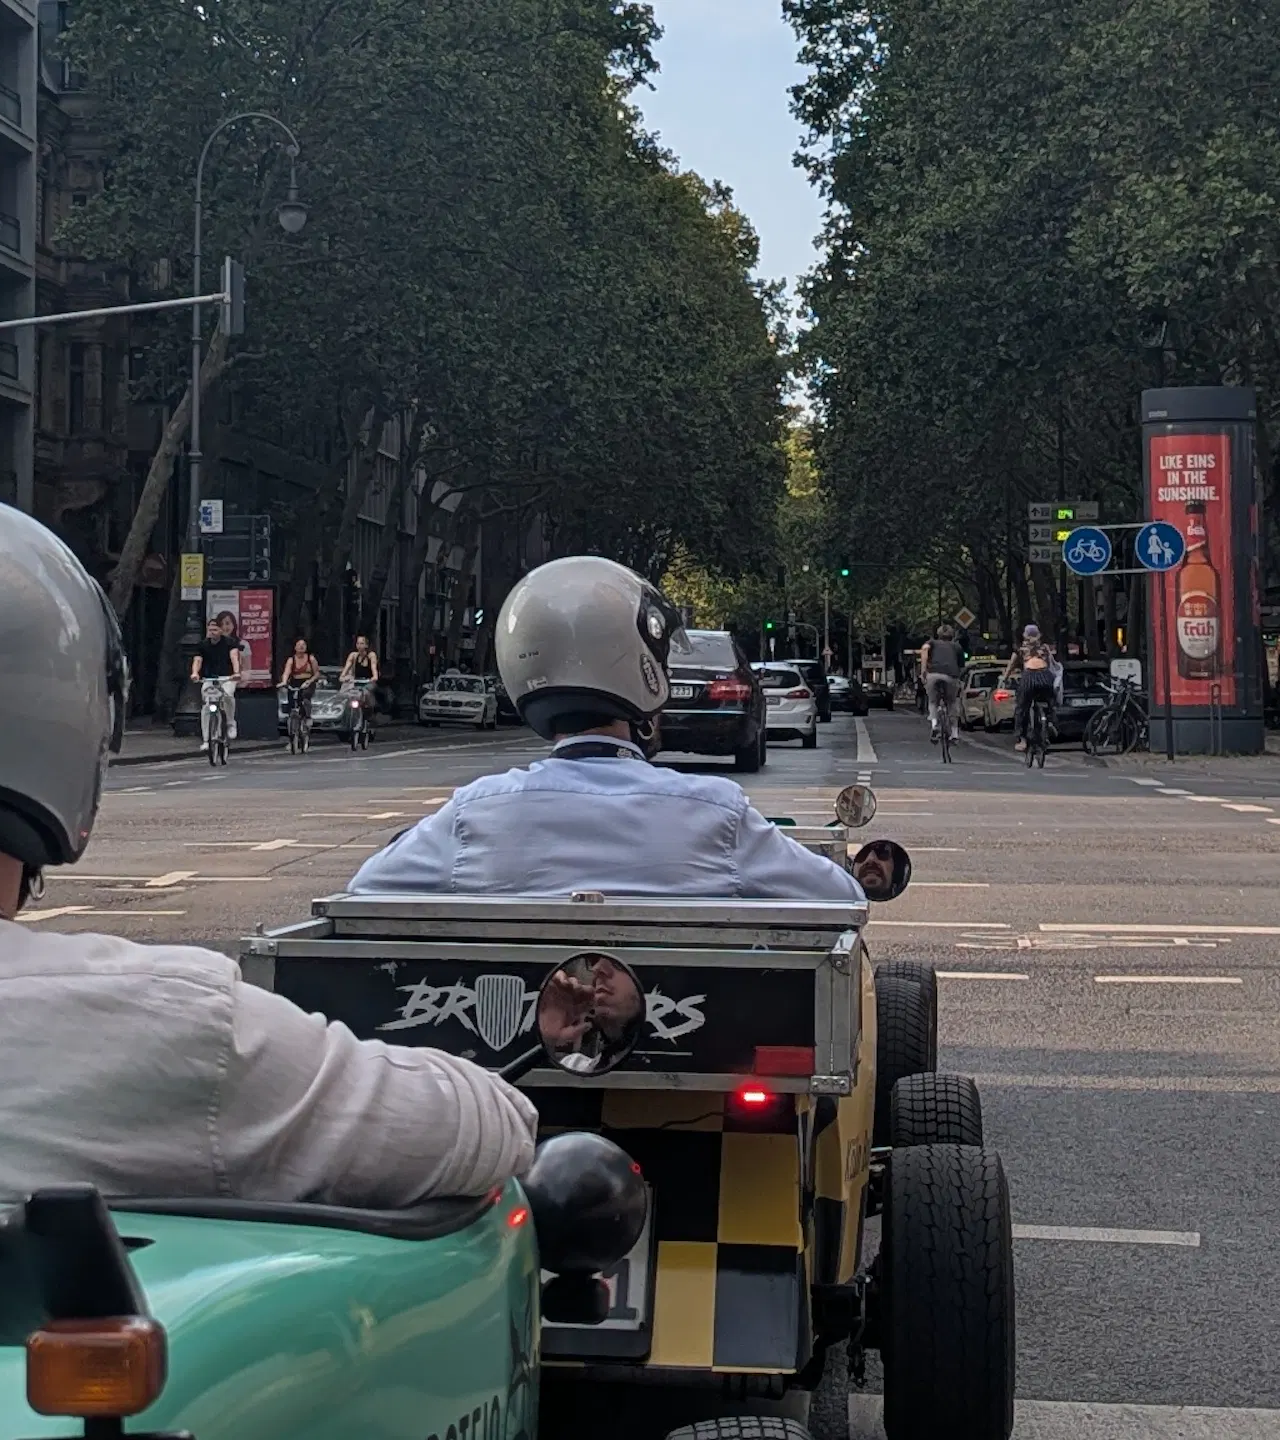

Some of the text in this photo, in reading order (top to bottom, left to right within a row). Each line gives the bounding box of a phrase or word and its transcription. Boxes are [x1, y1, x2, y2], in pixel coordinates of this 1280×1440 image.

[1160, 453, 1216, 470] LIKE EINS
[1167, 470, 1207, 486] IN THE
[1158, 486, 1220, 502] SUNSHINE.
[1183, 620, 1215, 638] früh
